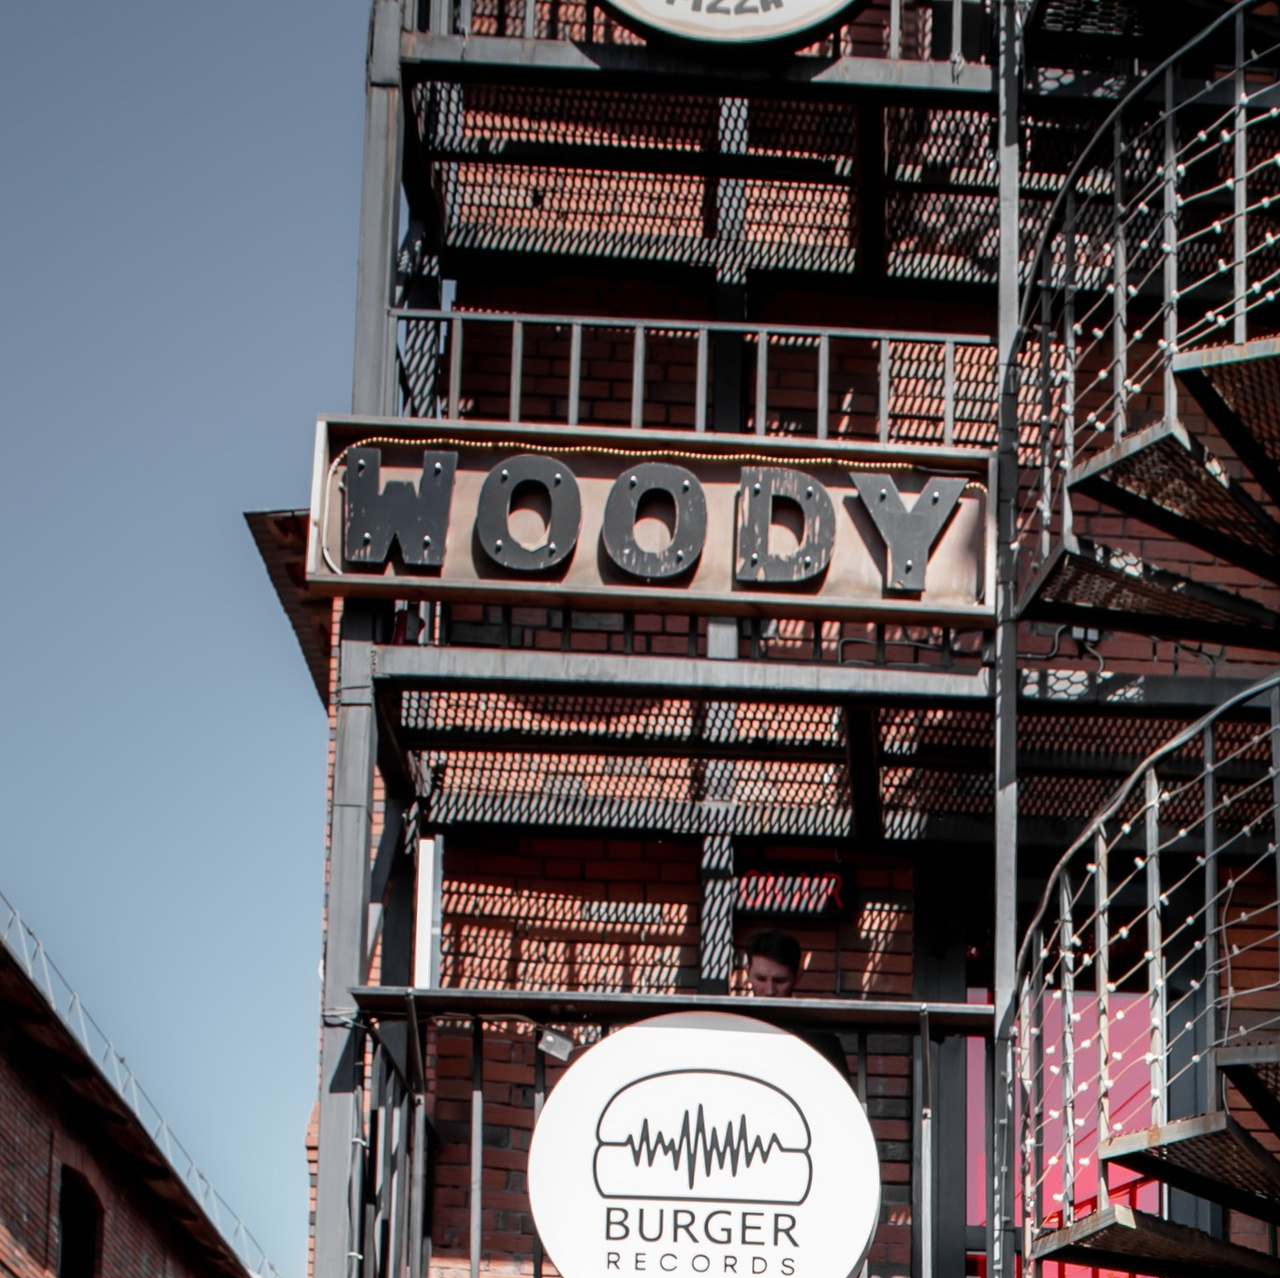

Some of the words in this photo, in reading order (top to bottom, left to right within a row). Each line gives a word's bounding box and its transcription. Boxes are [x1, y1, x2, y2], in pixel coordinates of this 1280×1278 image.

[344, 447, 970, 591] WOODY
[605, 1207, 800, 1248] BURGER
[606, 1251, 796, 1276] RECORDS
